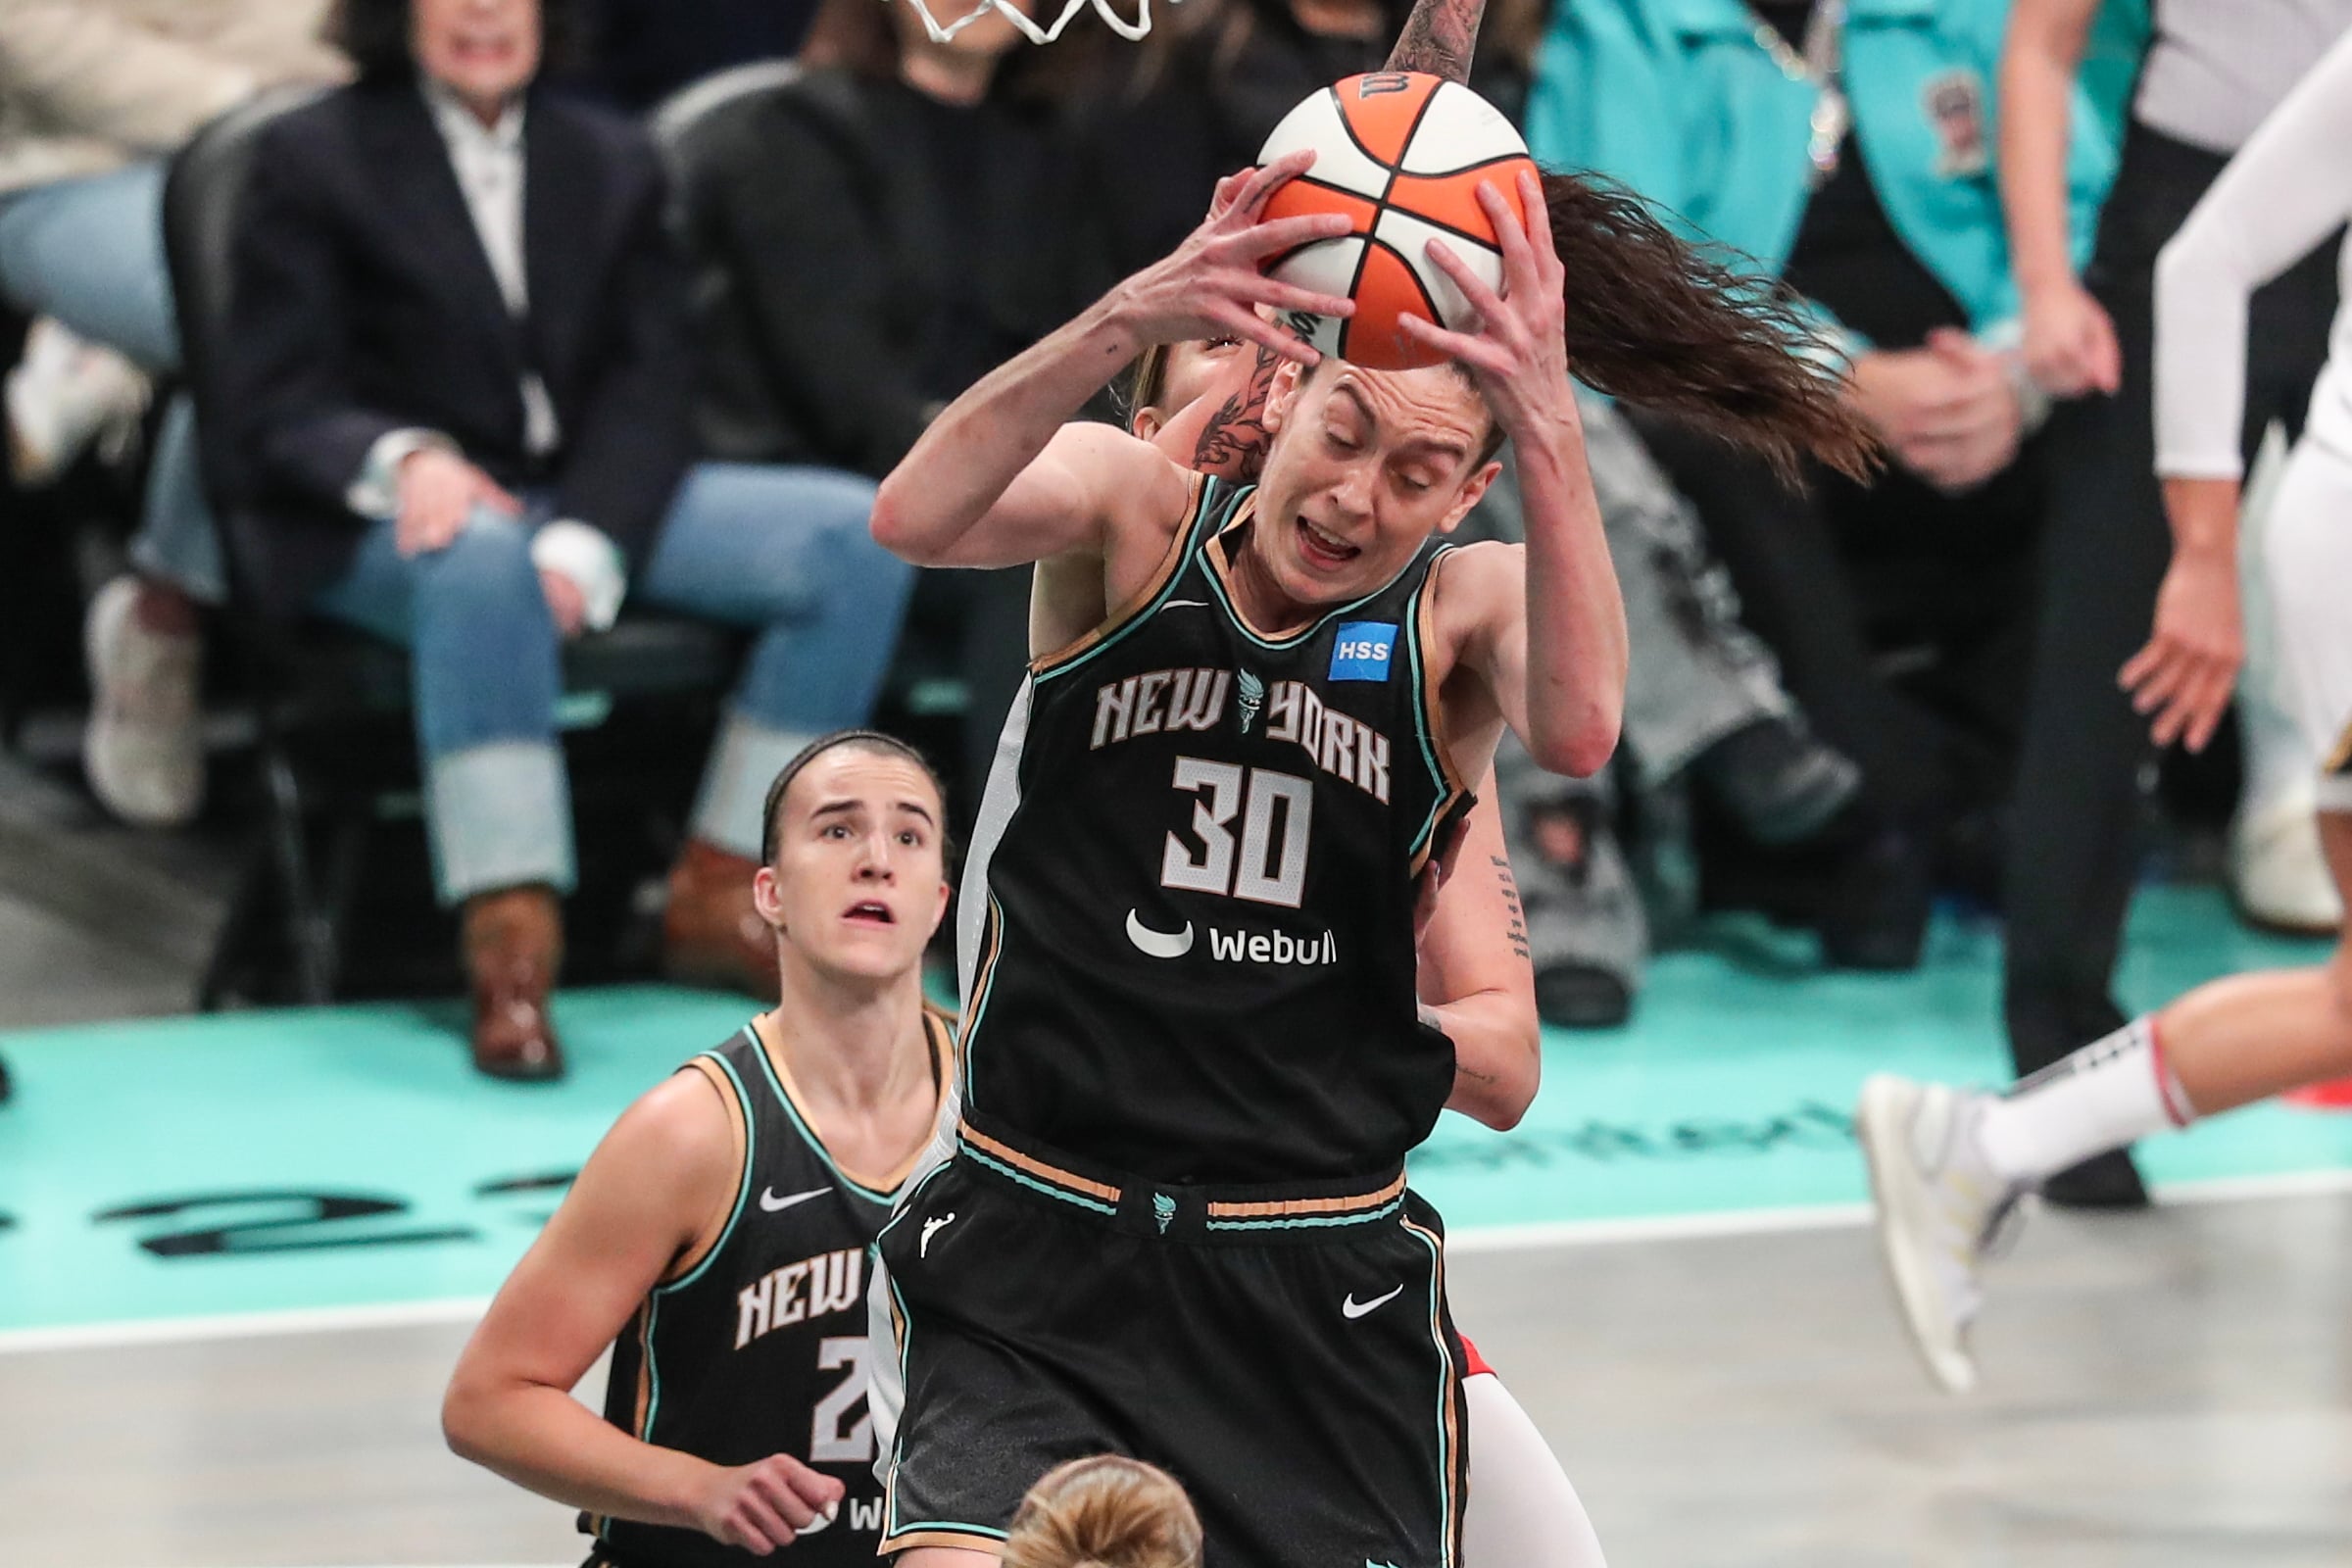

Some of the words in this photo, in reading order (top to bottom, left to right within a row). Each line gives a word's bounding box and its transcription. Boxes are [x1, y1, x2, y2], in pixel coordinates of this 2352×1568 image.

[1338, 640, 1389, 662] HSS
[1090, 667, 1232, 750] NEW
[1266, 680, 1391, 805] YORK
[1160, 756, 1313, 908] 30
[1208, 927, 1337, 964] Webull
[734, 1248, 864, 1351] NEW
[850, 1496, 885, 1531] W
